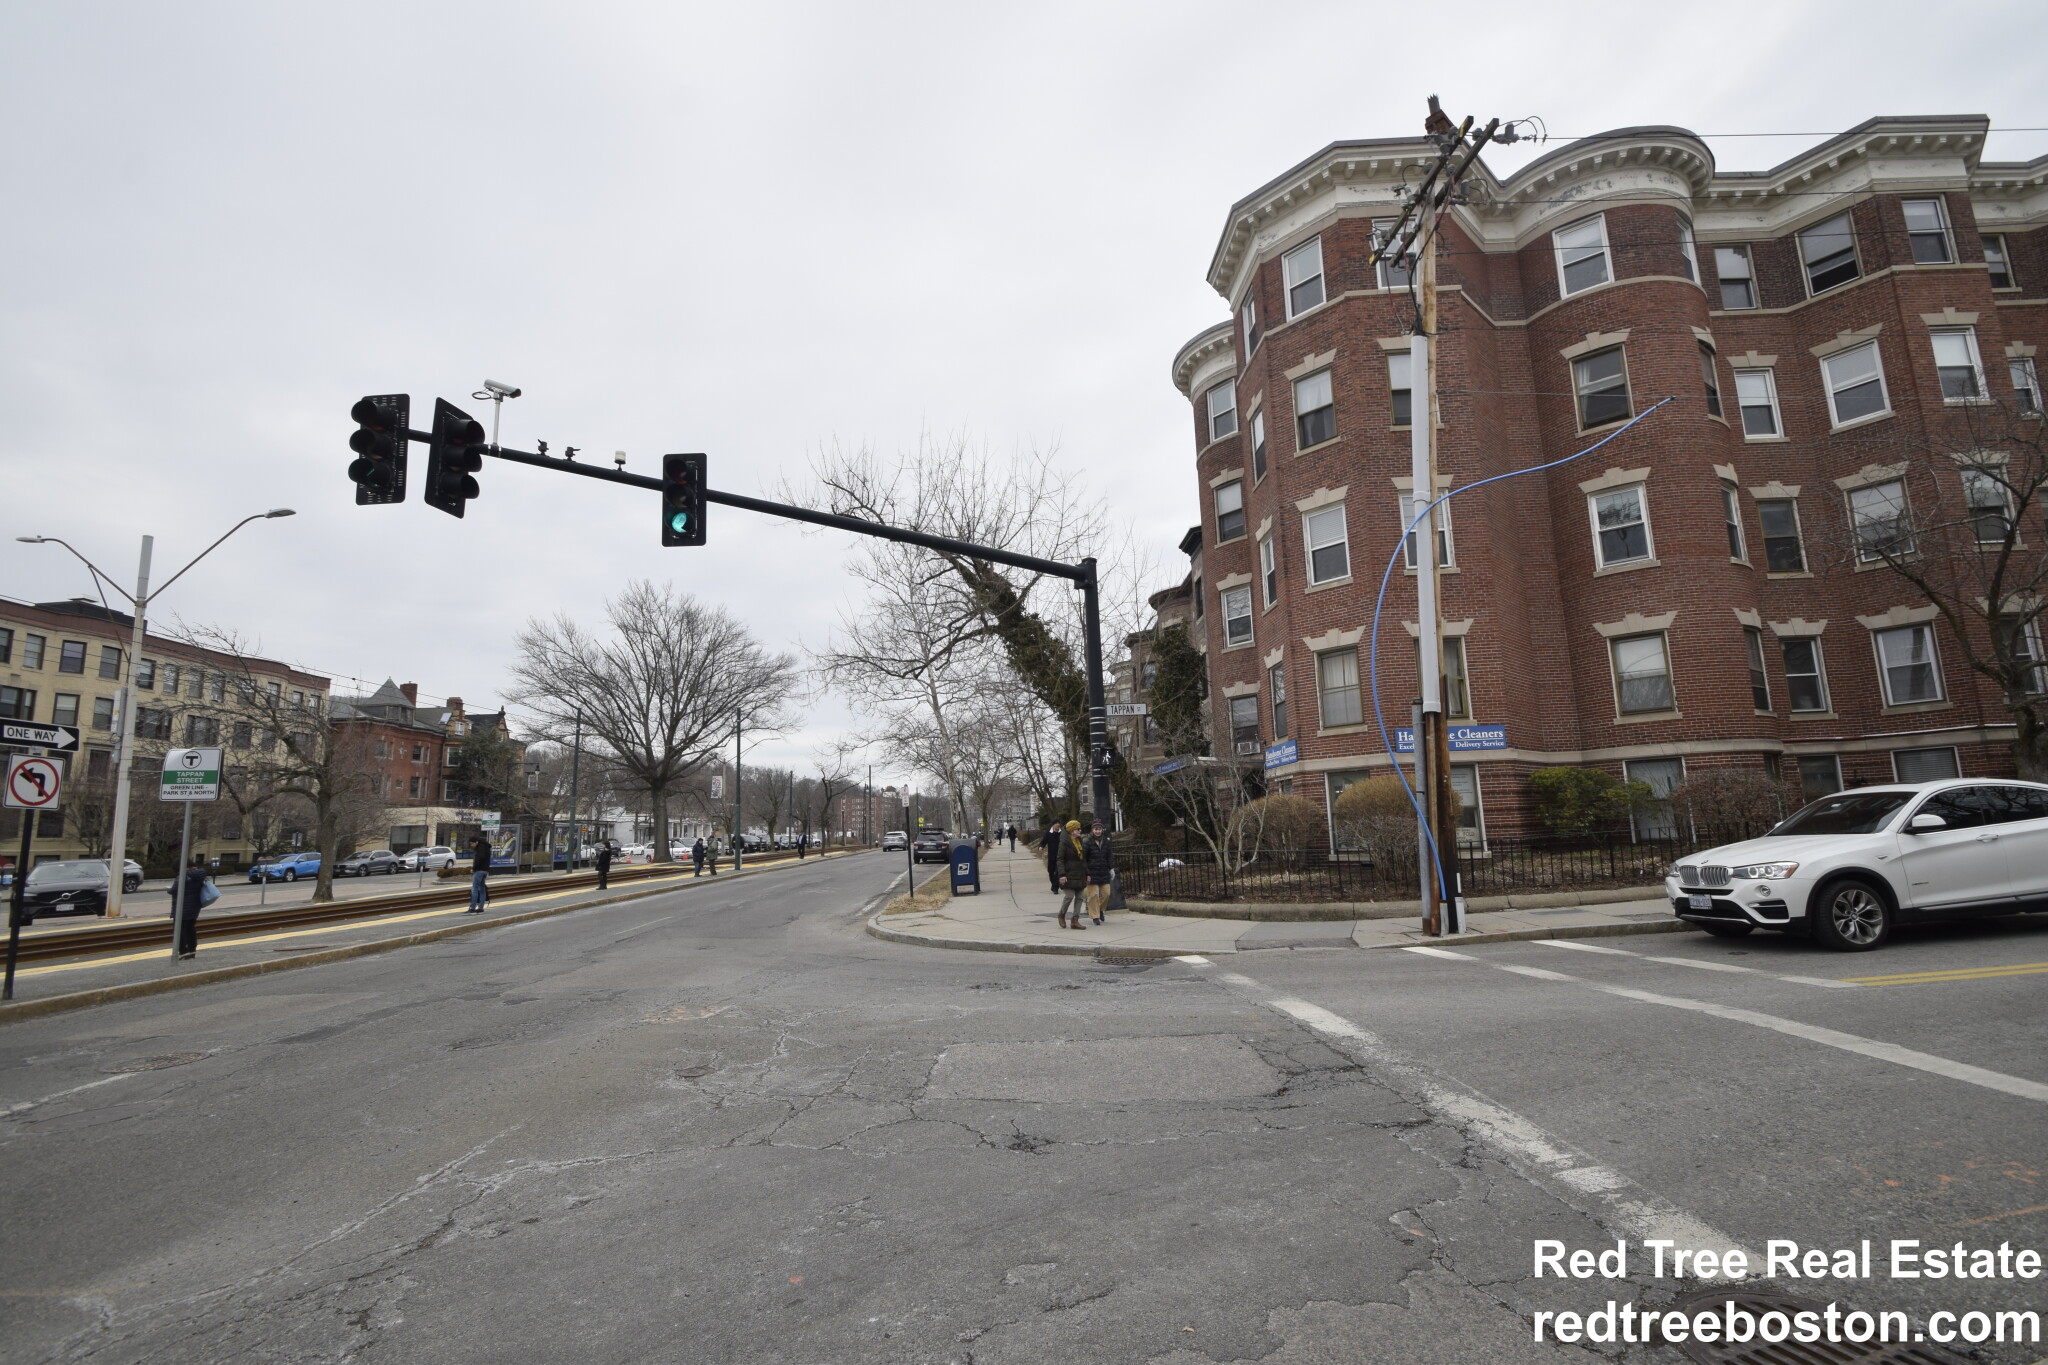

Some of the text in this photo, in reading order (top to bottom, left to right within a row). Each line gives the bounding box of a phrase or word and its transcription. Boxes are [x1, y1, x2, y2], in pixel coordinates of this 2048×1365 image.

[1111, 705, 1134, 714] TAPPAN
[7, 727, 57, 741] ONE WAY
[1458, 728, 1504, 739] Cleaners
[1455, 741, 1481, 749] Delivery
[186, 756, 198, 766] T
